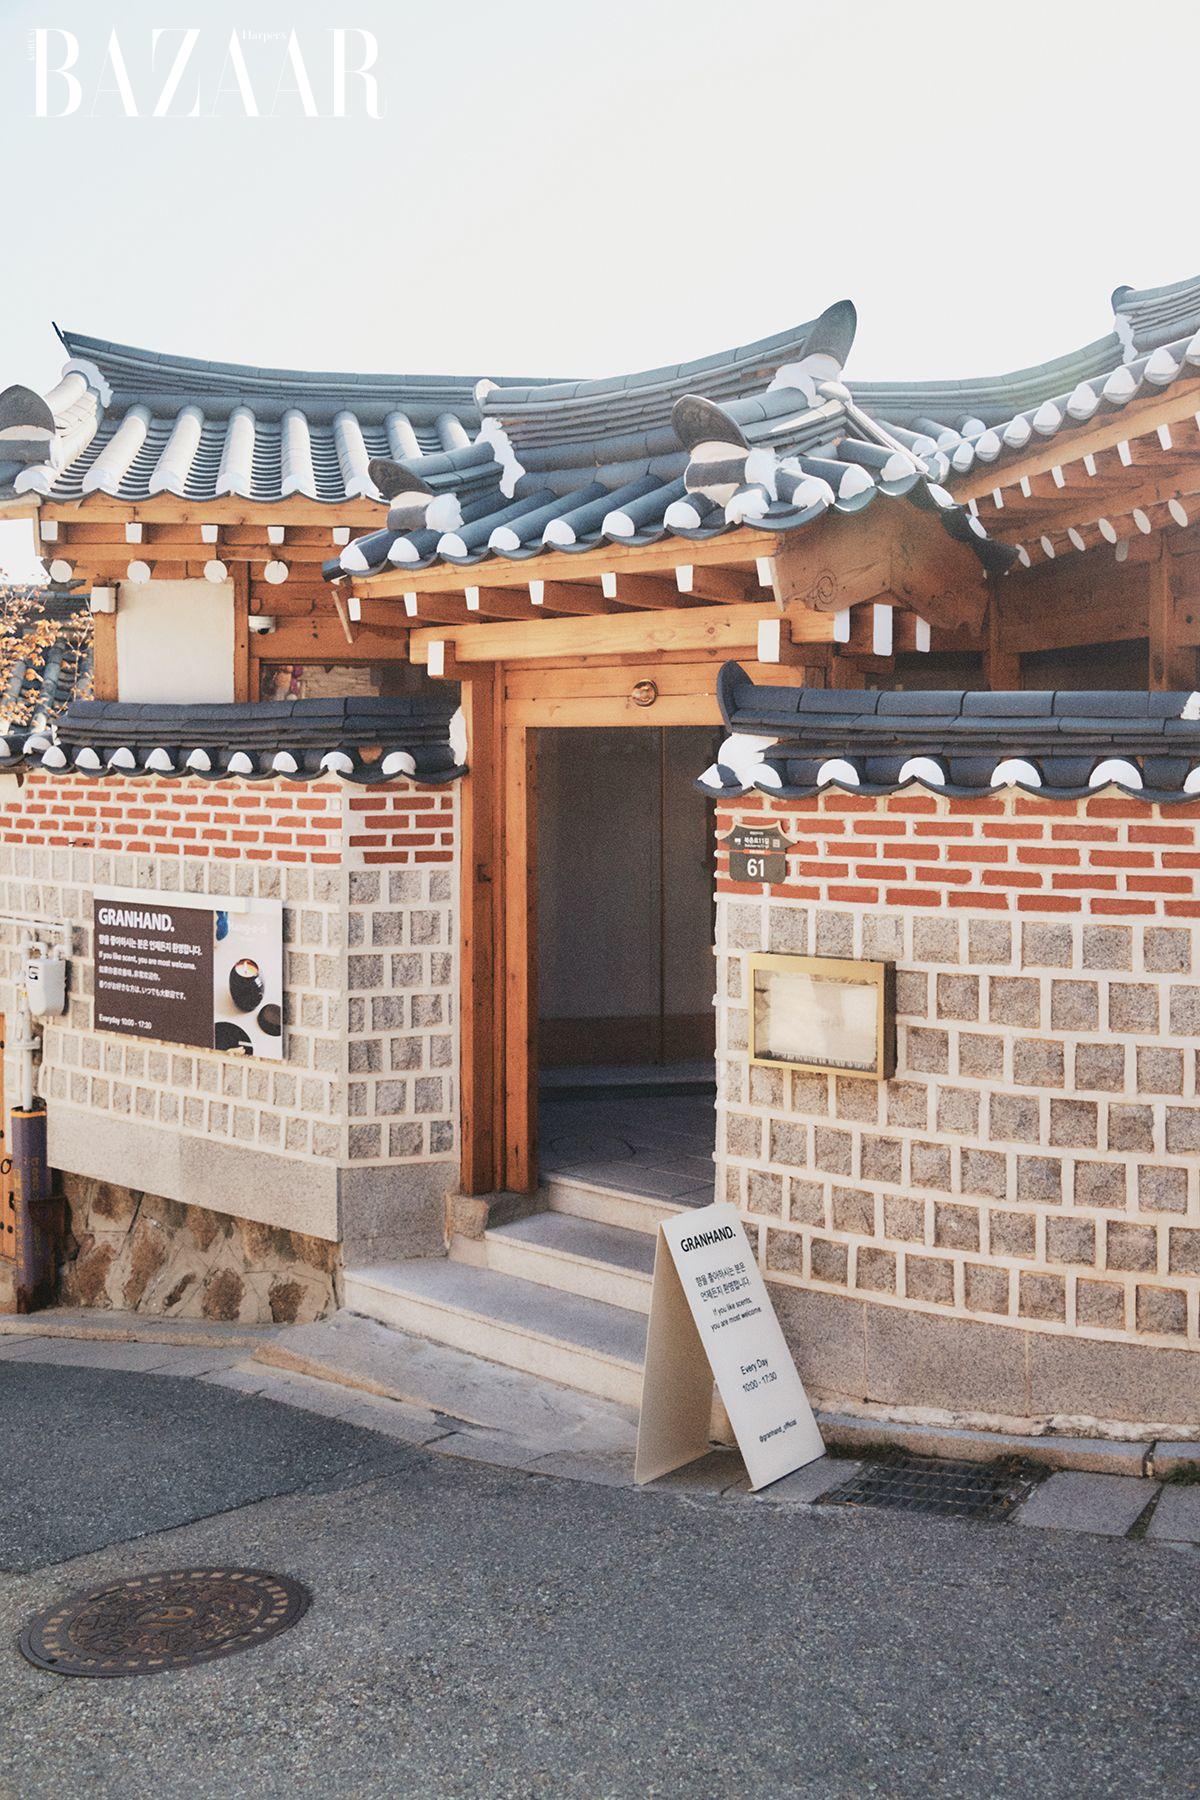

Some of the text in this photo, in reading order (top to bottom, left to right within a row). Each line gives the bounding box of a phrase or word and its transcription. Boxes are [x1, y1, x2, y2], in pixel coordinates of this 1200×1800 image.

[747, 858, 765, 877] 61
[98, 907, 175, 932] GRANHAND.
[680, 1225, 736, 1252] GRANHAND.
[700, 1285, 724, 1302] 언제든지
[717, 1306, 727, 1316] you
[726, 1302, 735, 1311] like
[711, 1321, 721, 1332] you
[720, 1318, 729, 1328] are
[740, 1358, 768, 1376] Every Day
[742, 1379, 758, 1392] 10:00
[761, 1371, 777, 1385] 17:30
